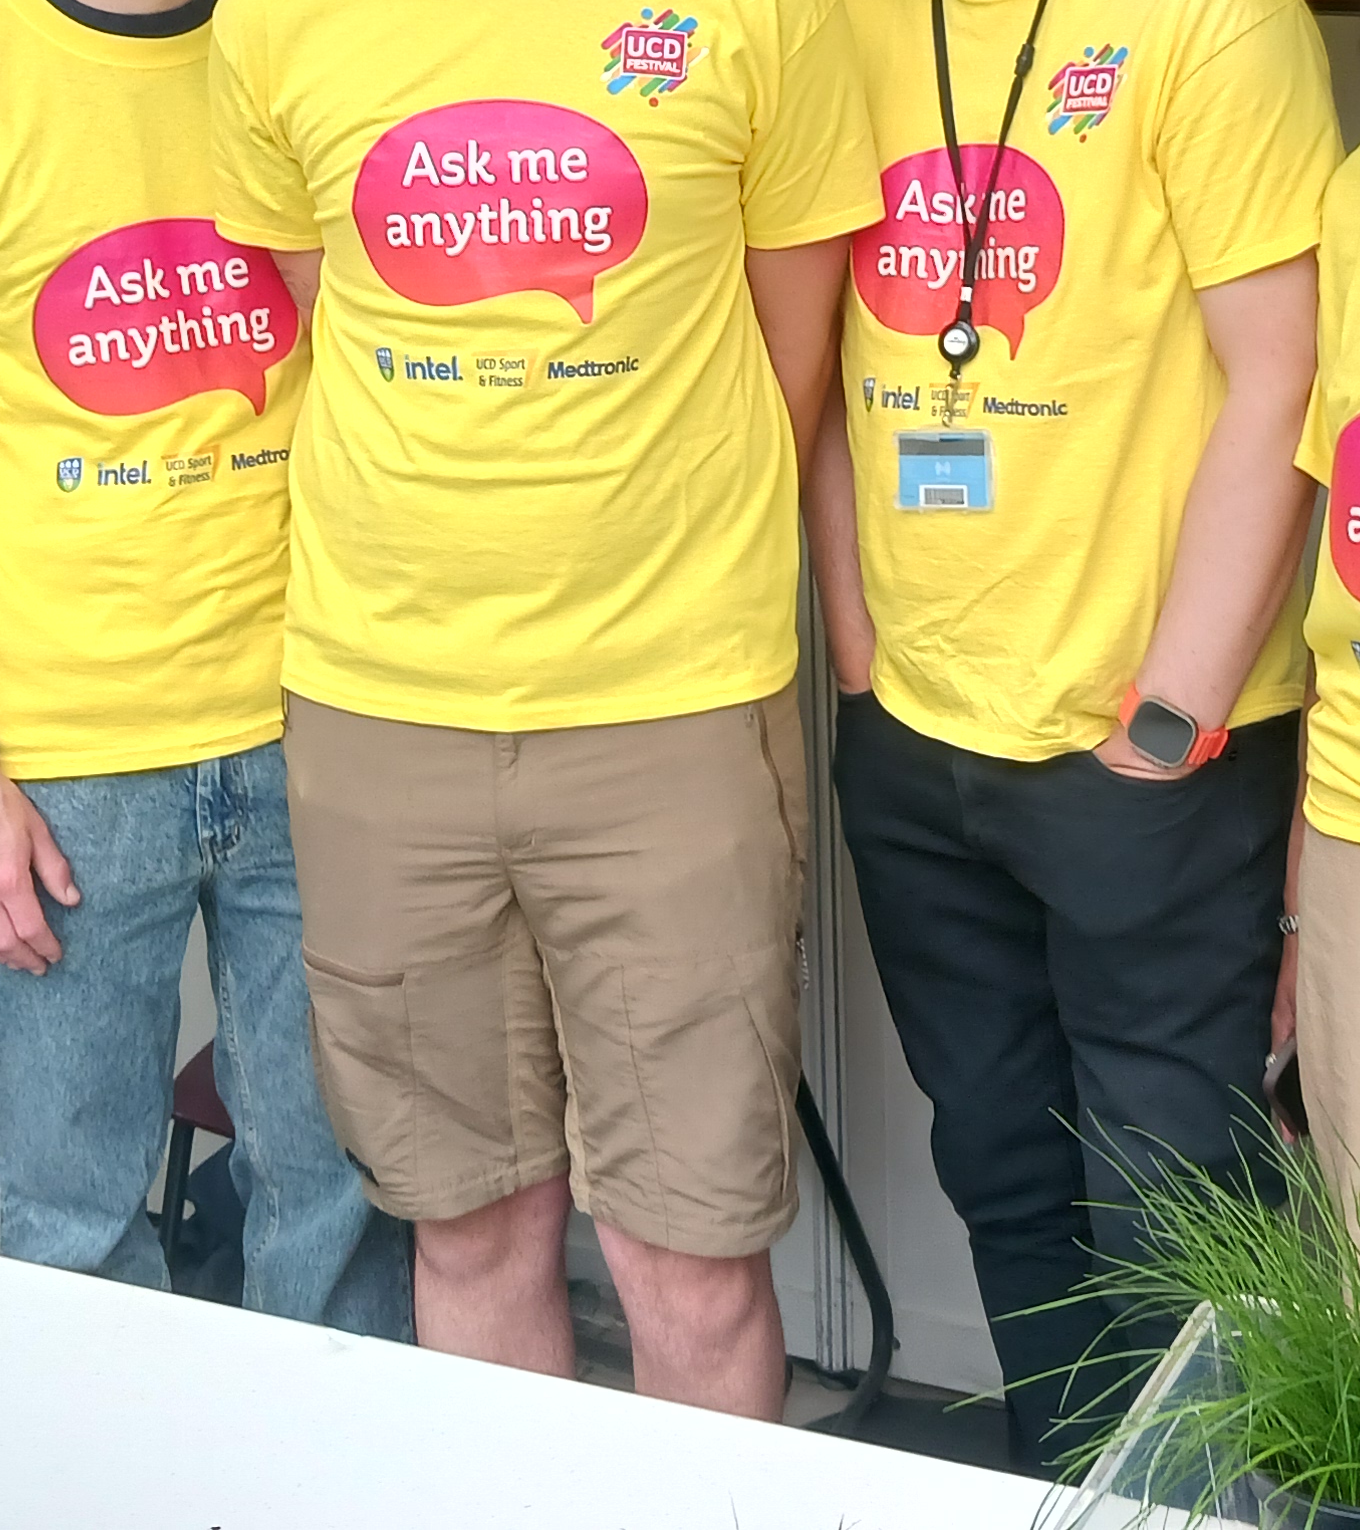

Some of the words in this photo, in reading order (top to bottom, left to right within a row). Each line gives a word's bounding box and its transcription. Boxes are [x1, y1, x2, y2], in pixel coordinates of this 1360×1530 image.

[624, 33, 684, 60] UCD
[625, 59, 686, 74] FESTIVAL
[1069, 73, 1112, 97] UCD
[1066, 95, 1109, 110] FESTIVAL
[401, 140, 496, 188] Ask
[508, 143, 590, 185] me
[385, 198, 614, 257] anything
[84, 258, 170, 309] Ask
[176, 257, 249, 295] me
[68, 306, 275, 368] anything
[476, 358, 496, 370] UCD
[499, 357, 526, 371] Sport
[547, 356, 639, 379] Medtronic
[489, 375, 523, 387] Fitness
[983, 397, 1068, 417] Medtronic
[231, 448, 289, 471] Medtro
